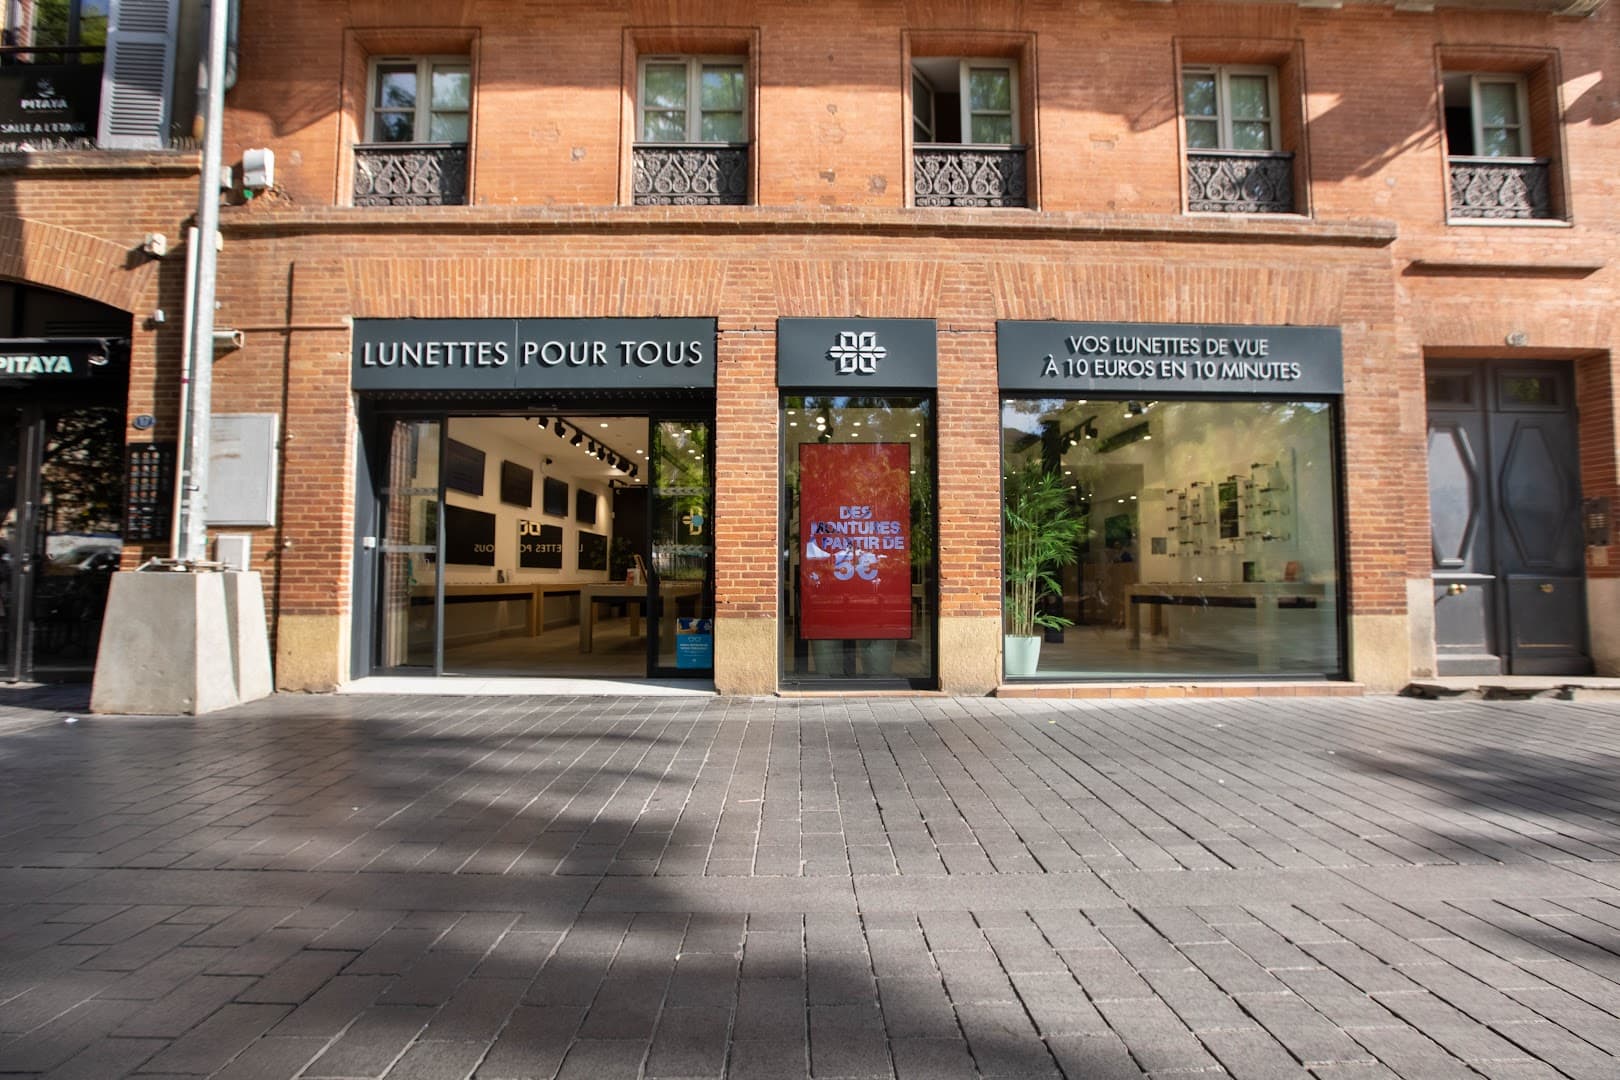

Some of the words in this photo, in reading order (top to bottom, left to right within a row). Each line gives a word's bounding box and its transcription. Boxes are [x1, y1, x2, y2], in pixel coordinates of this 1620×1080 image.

[21, 99, 68, 110] PITAYA
[363, 341, 509, 366] LUNETTES
[524, 341, 607, 366] POUR
[621, 340, 702, 365] TOUS
[1070, 335, 1109, 353] VOS
[1115, 336, 1200, 354] LUNETTES
[1206, 338, 1228, 355] DE
[1233, 339, 1269, 356] VUE
[1045, 354, 1059, 376] À
[1067, 358, 1088, 376] 10
[1094, 359, 1156, 377] EUROS
[1161, 360, 1187, 378] EN
[1194, 361, 1216, 378] 10
[1222, 361, 1301, 379] MINUTES
[840, 506, 872, 519] DES
[883, 536, 904, 549] DE
[834, 552, 878, 580] 5€
